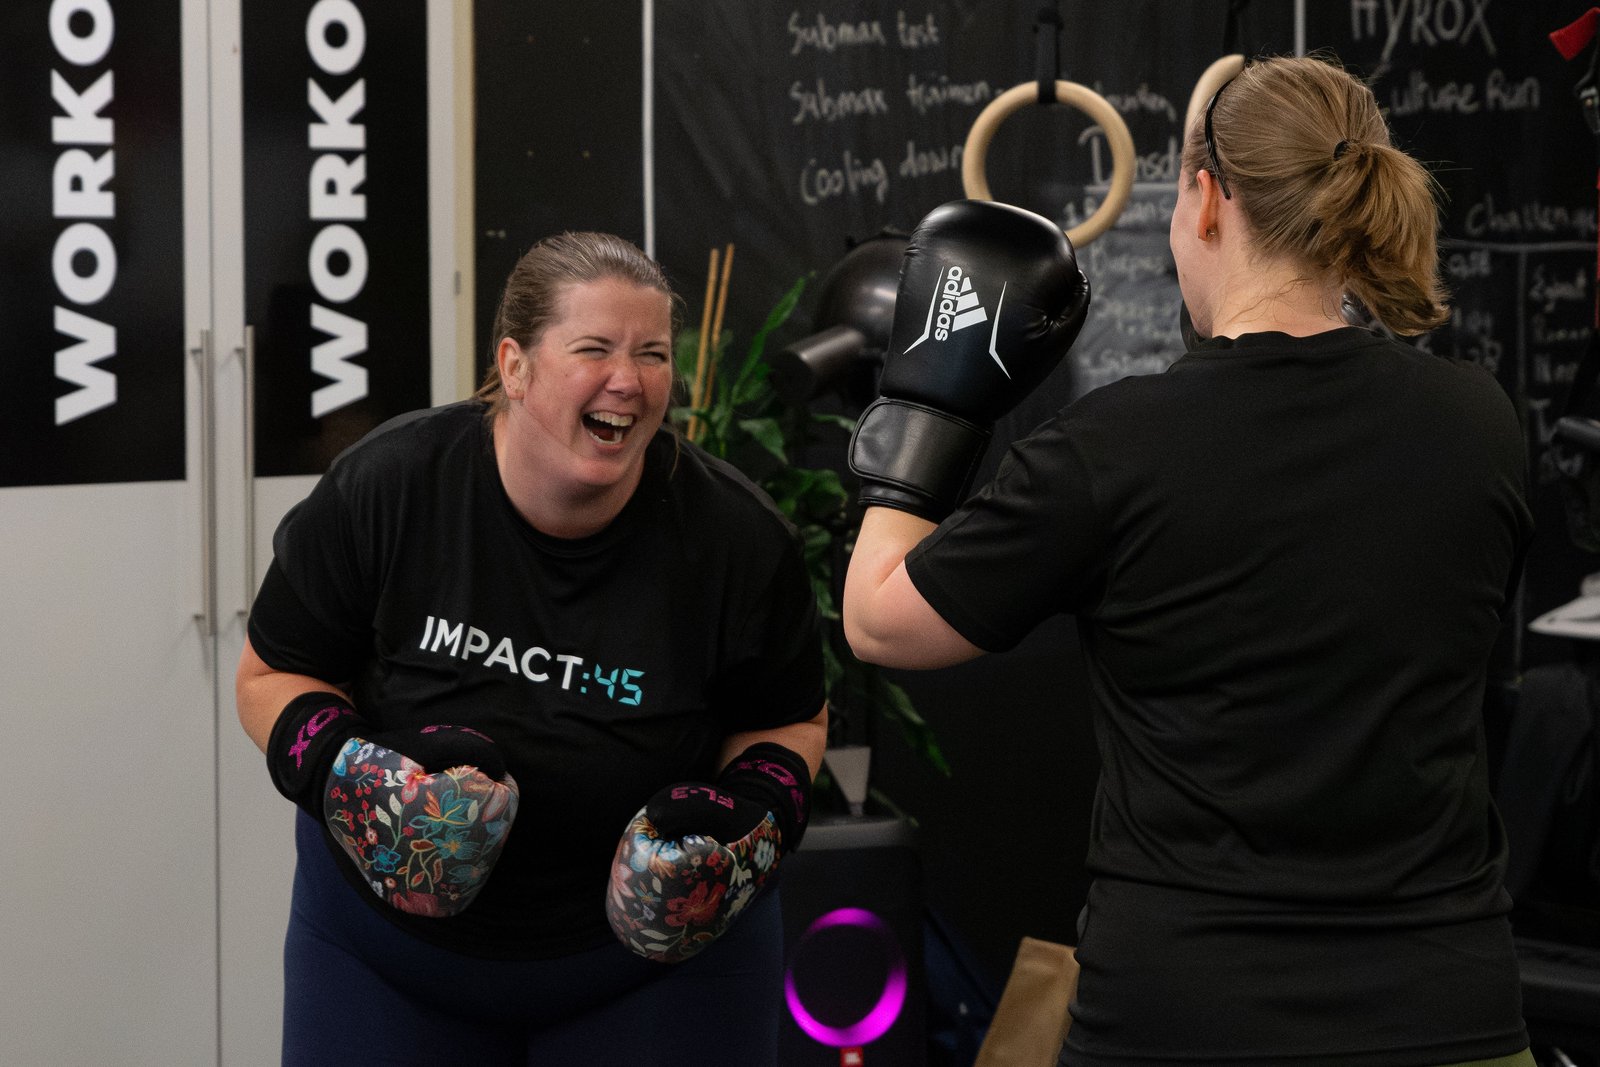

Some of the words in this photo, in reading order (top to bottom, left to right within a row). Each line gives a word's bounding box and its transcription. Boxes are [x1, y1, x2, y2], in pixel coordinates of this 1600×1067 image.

[49, 0, 118, 426] WORKO
[305, 0, 369, 419] WORKO
[934, 265, 963, 342] adidas
[418, 615, 646, 707] IMPACT:45
